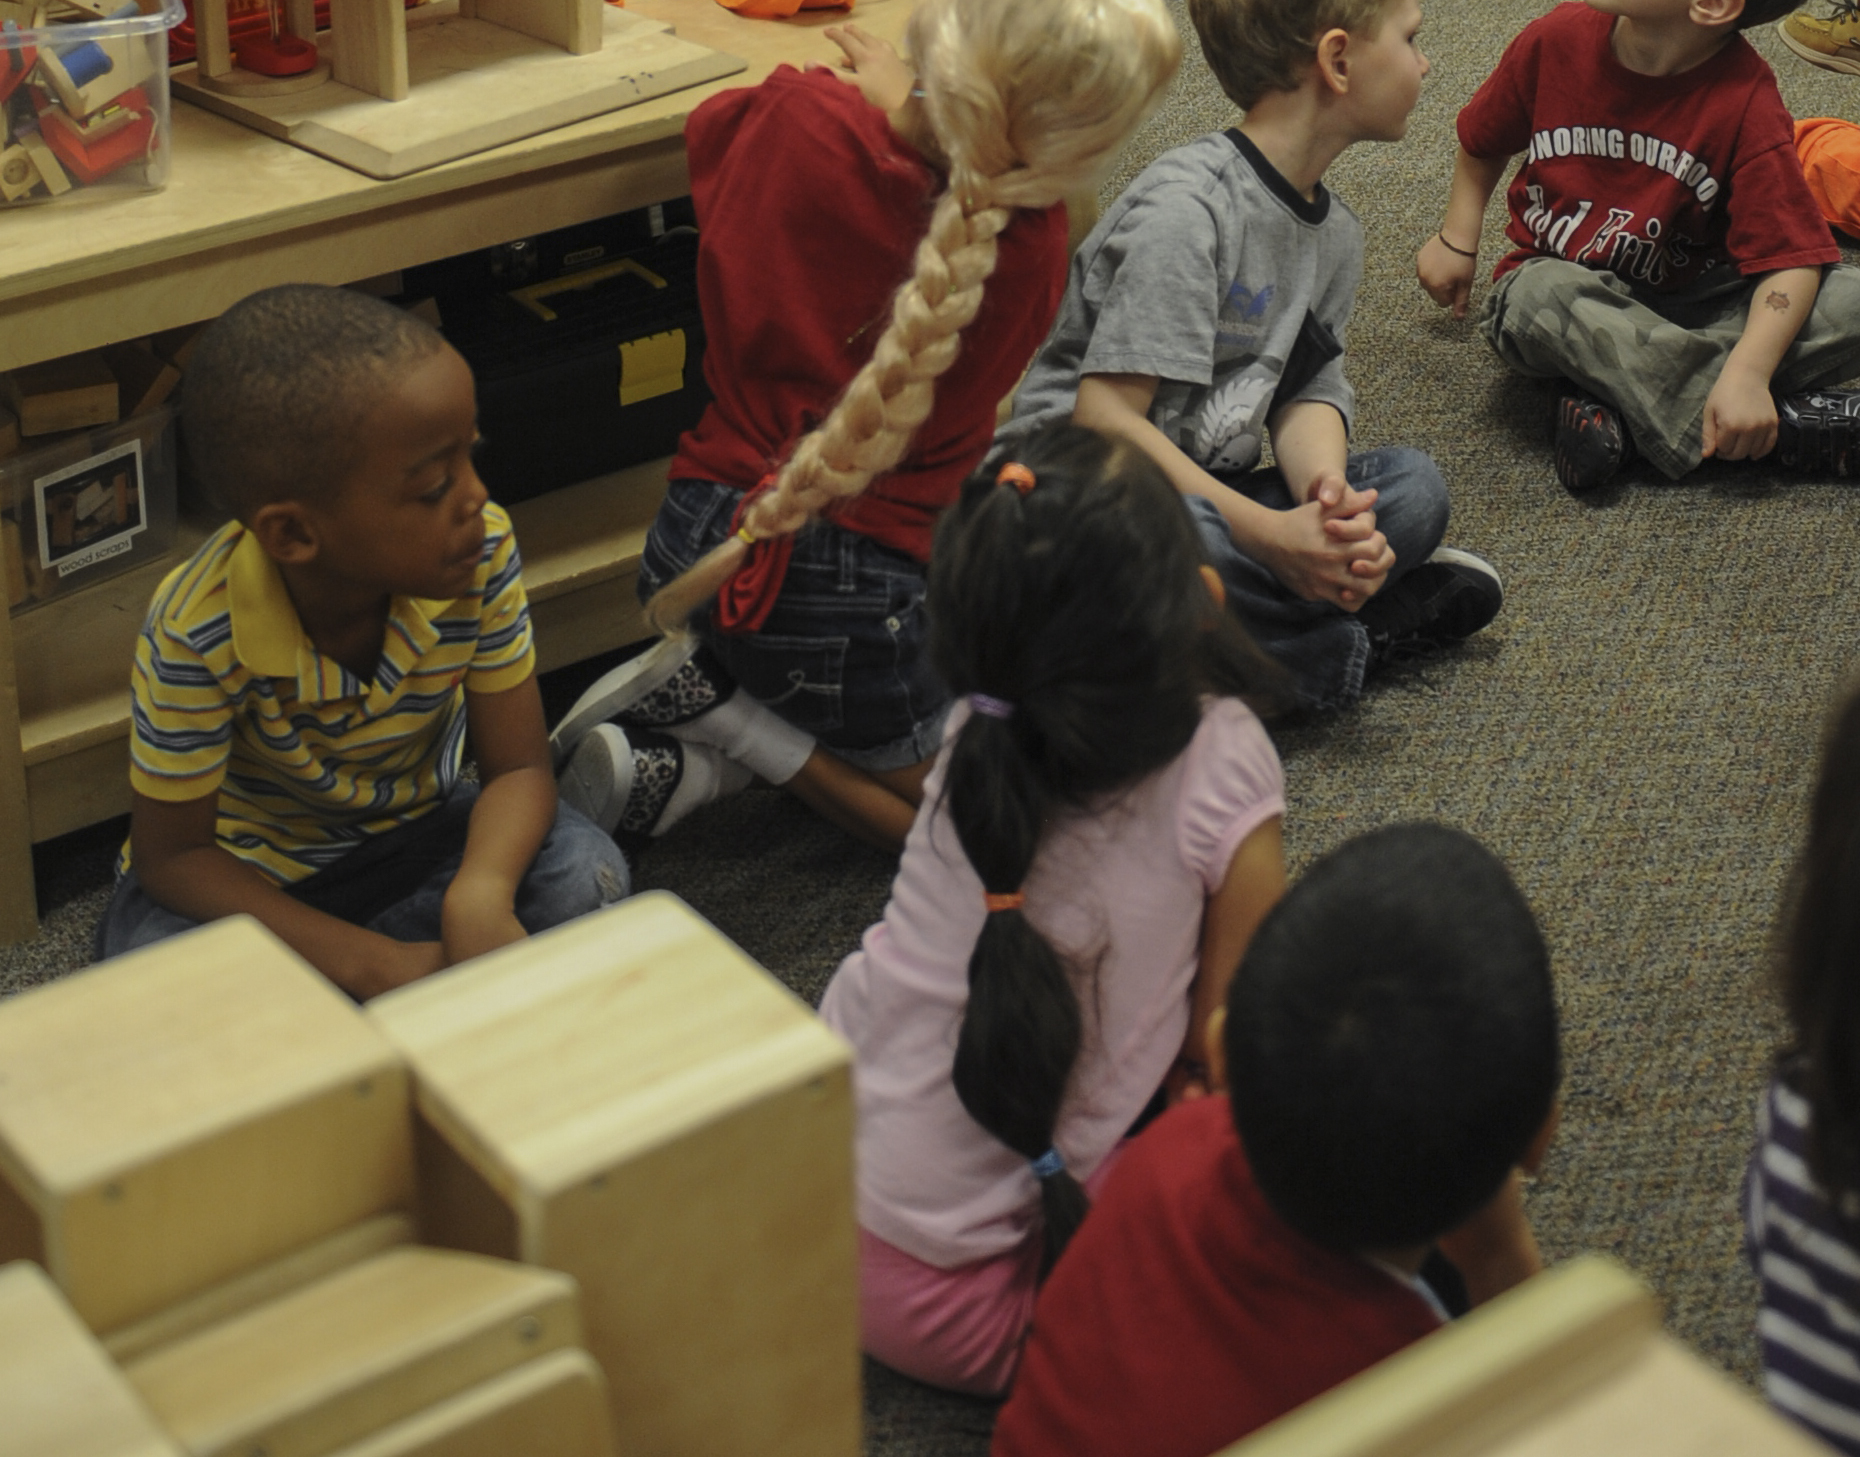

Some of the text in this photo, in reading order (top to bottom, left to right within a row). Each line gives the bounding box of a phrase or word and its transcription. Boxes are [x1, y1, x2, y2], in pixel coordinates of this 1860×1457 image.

[1529, 126, 1625, 165] NORING
[1629, 132, 1678, 175] OUR
[60, 539, 130, 574] wood scraps
